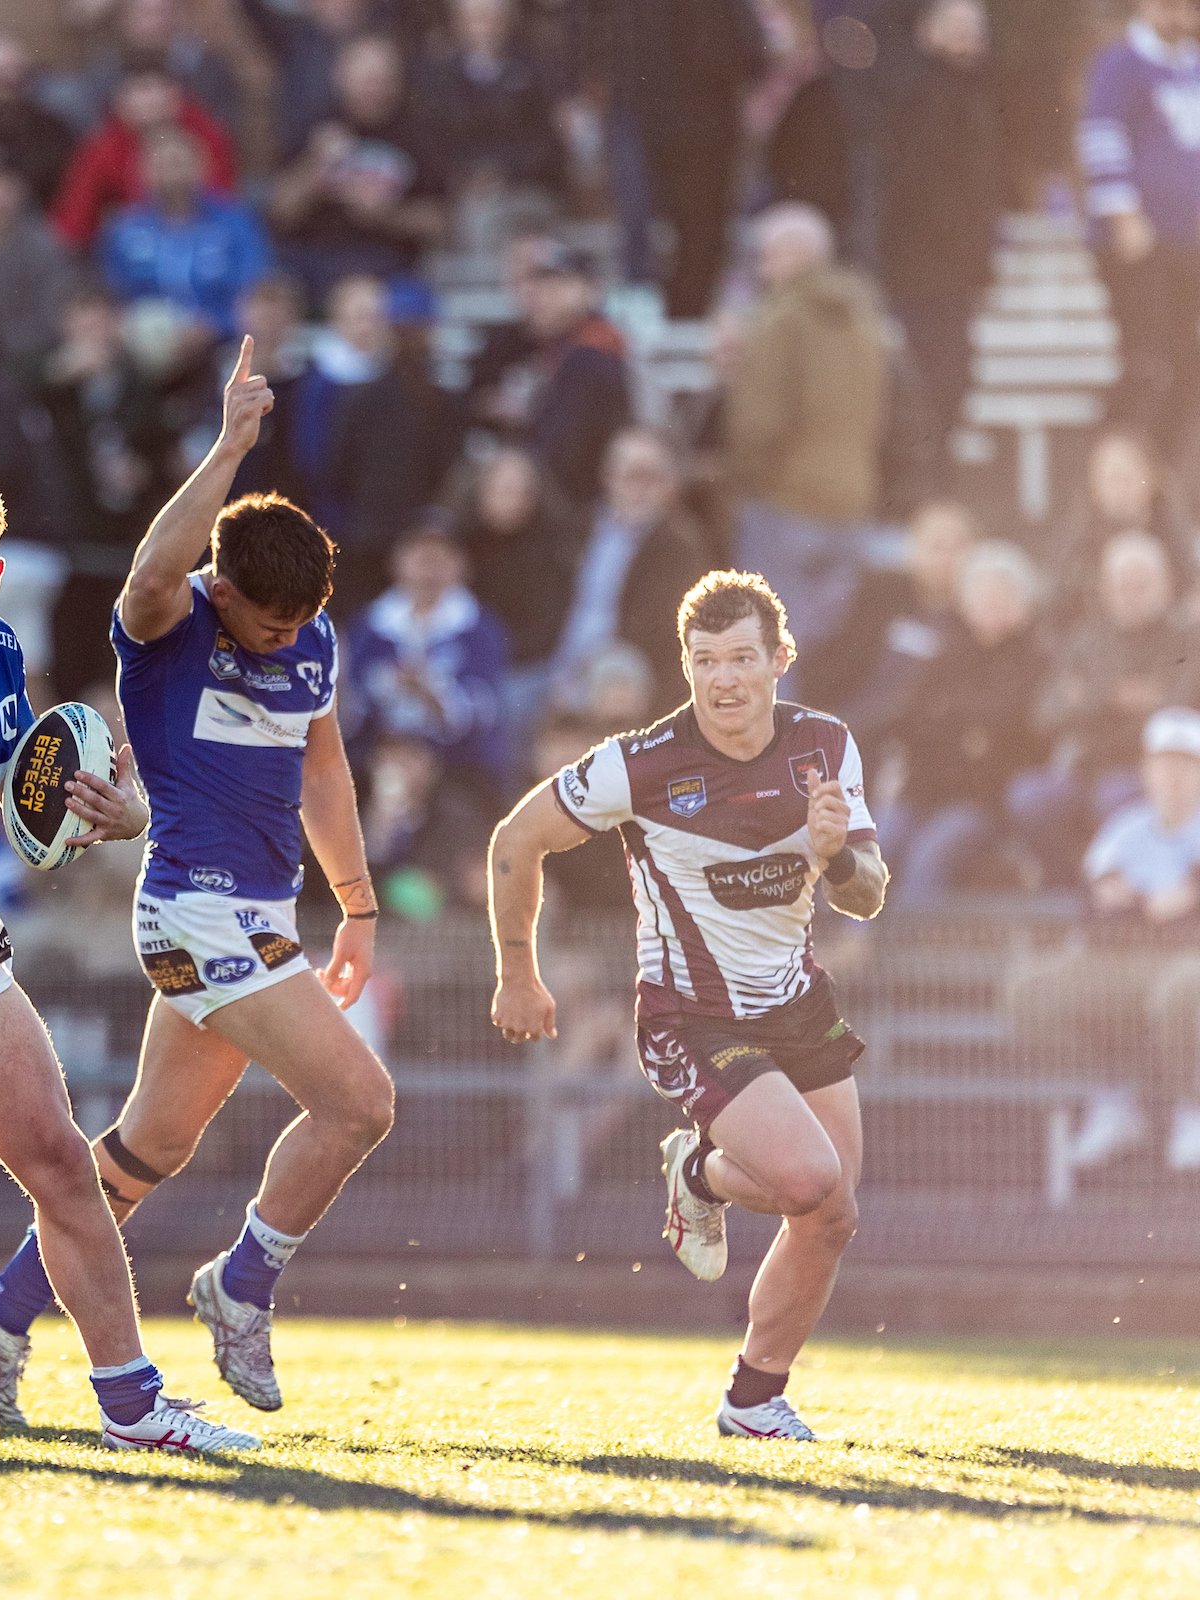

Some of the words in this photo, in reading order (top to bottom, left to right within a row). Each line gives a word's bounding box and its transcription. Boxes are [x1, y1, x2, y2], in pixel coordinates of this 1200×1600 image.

[19, 734, 51, 811] EFFECT
[33, 737, 63, 813] KNOCK-ON
[49, 766, 63, 788] THE
